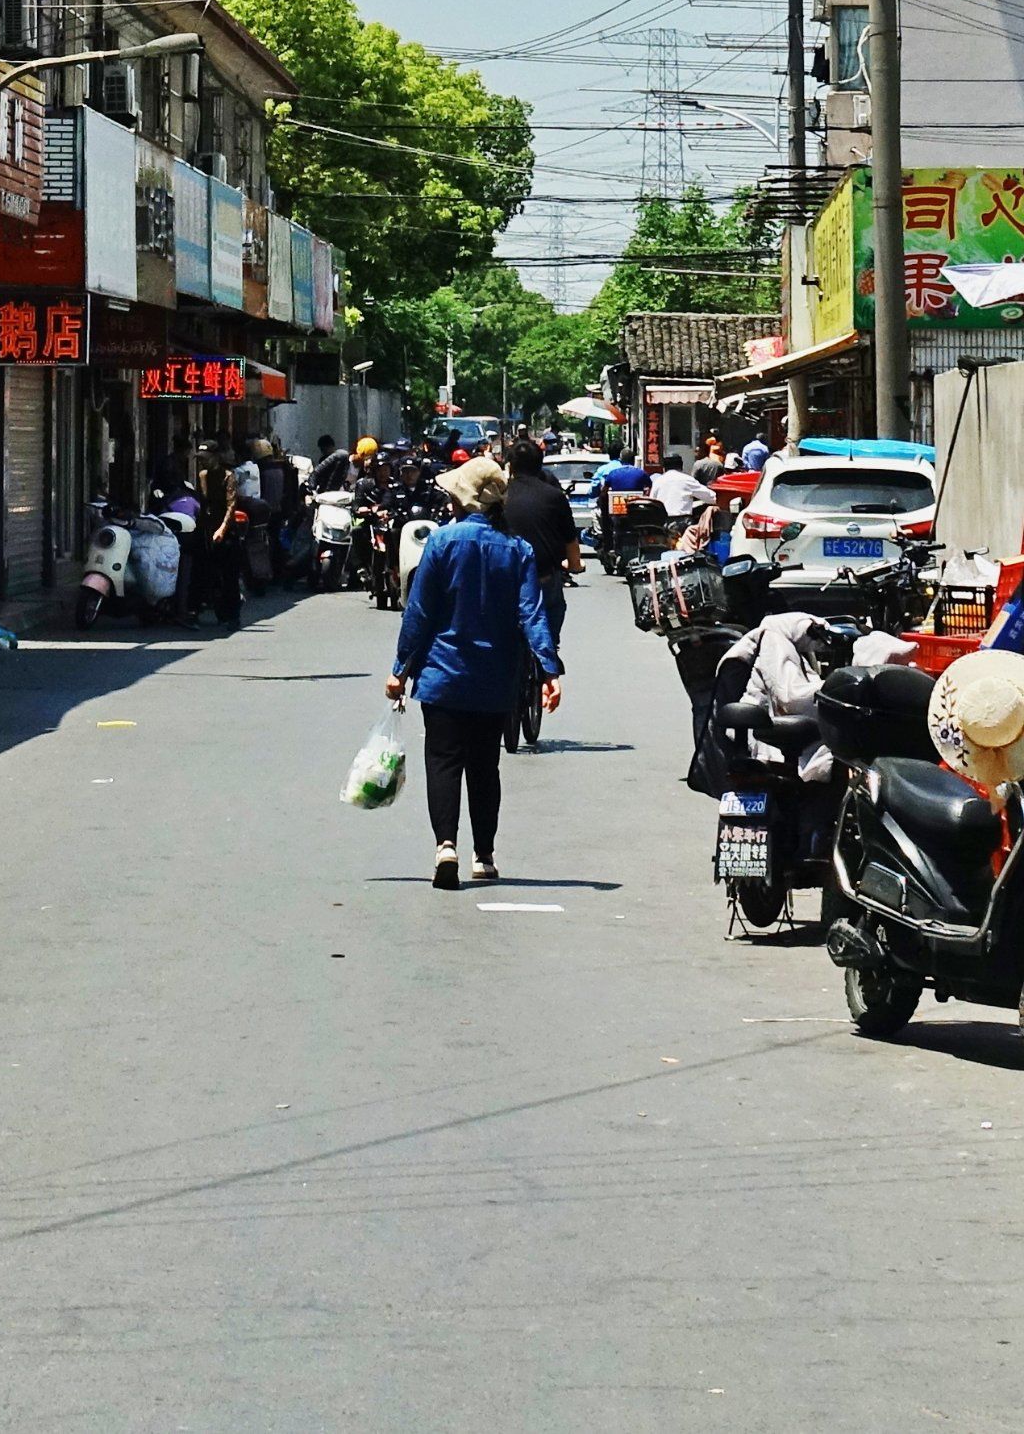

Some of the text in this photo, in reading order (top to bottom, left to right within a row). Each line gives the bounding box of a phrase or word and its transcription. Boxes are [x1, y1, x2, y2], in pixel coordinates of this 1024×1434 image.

[144, 361, 242, 398] 双汇生鲜肉
